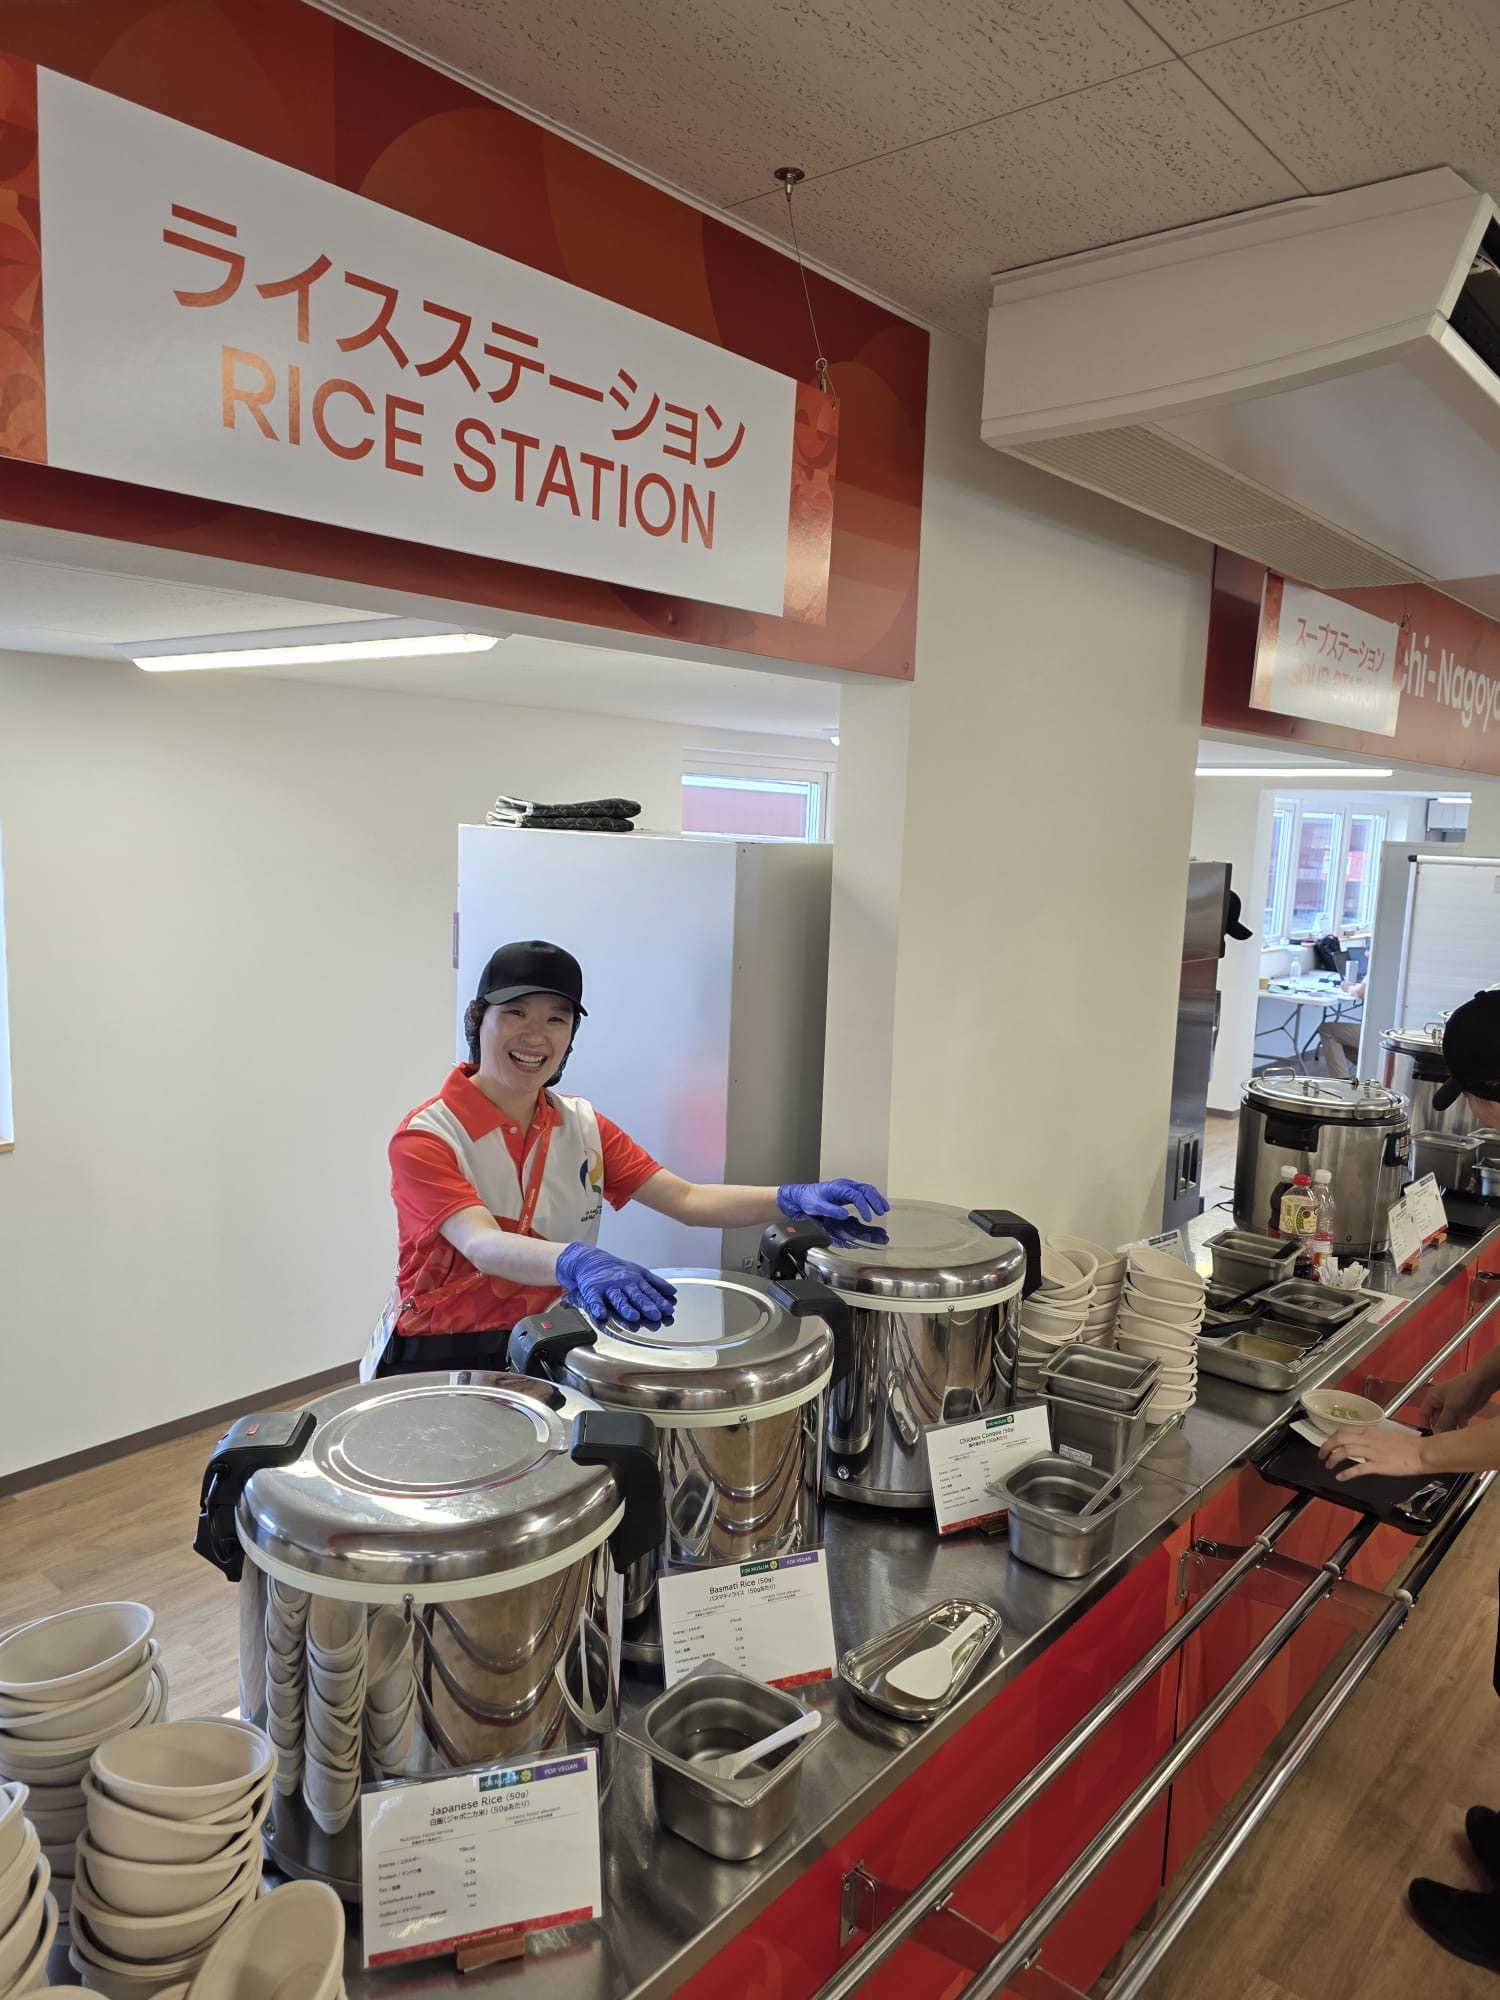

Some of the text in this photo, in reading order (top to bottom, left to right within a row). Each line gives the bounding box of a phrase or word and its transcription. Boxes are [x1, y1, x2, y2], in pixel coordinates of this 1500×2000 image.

[163, 203, 745, 469] ライスステーション
[221, 344, 716, 549] RICE STATION
[1296, 618, 1385, 672] スープステーション
[709, 1575, 775, 1594] Basmati Rice (50g)
[544, 1762, 578, 1776] FOR VEGAN
[430, 1789, 529, 1816] Japanese Rice (50g)
